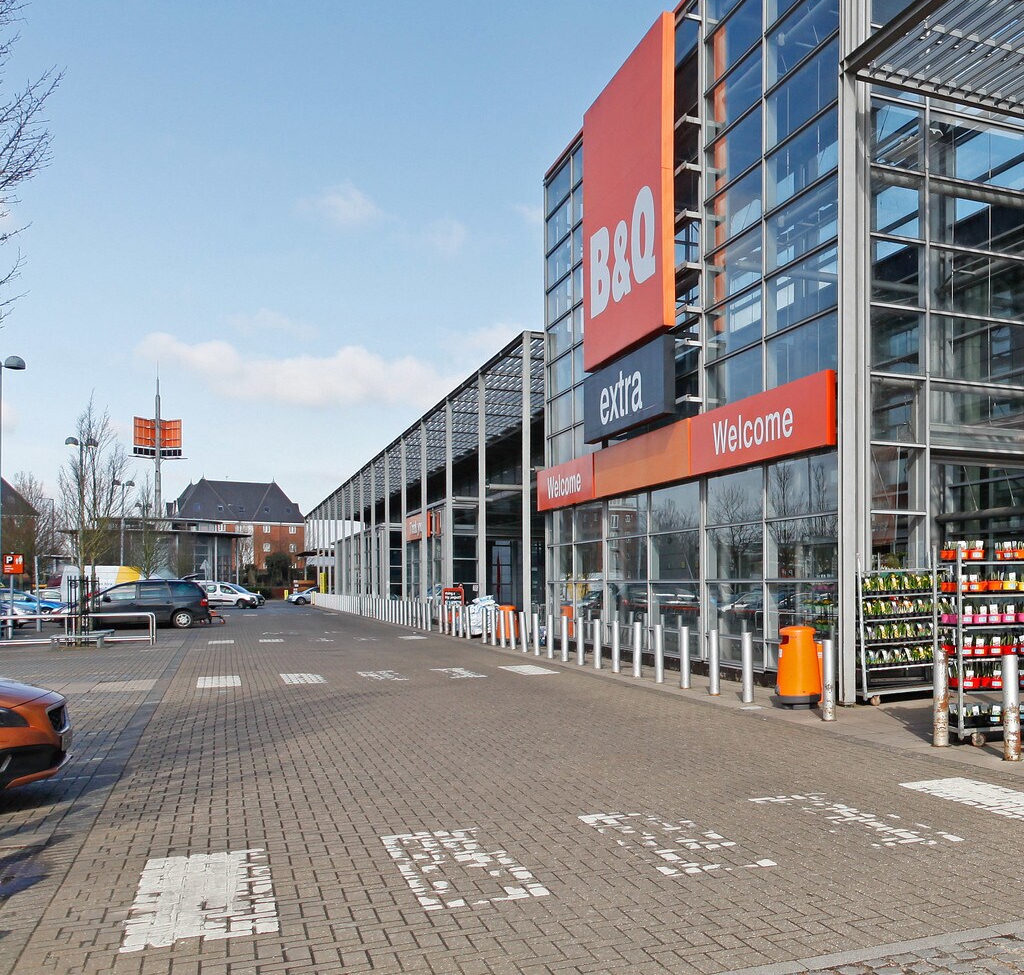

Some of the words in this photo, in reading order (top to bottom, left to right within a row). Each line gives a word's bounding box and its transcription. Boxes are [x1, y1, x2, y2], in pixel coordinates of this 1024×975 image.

[590, 185, 656, 319] B&Q
[600, 370, 643, 425] extra
[712, 407, 794, 456] Welcome
[547, 472, 581, 499] Welcome
[6, 556, 13, 564] P
